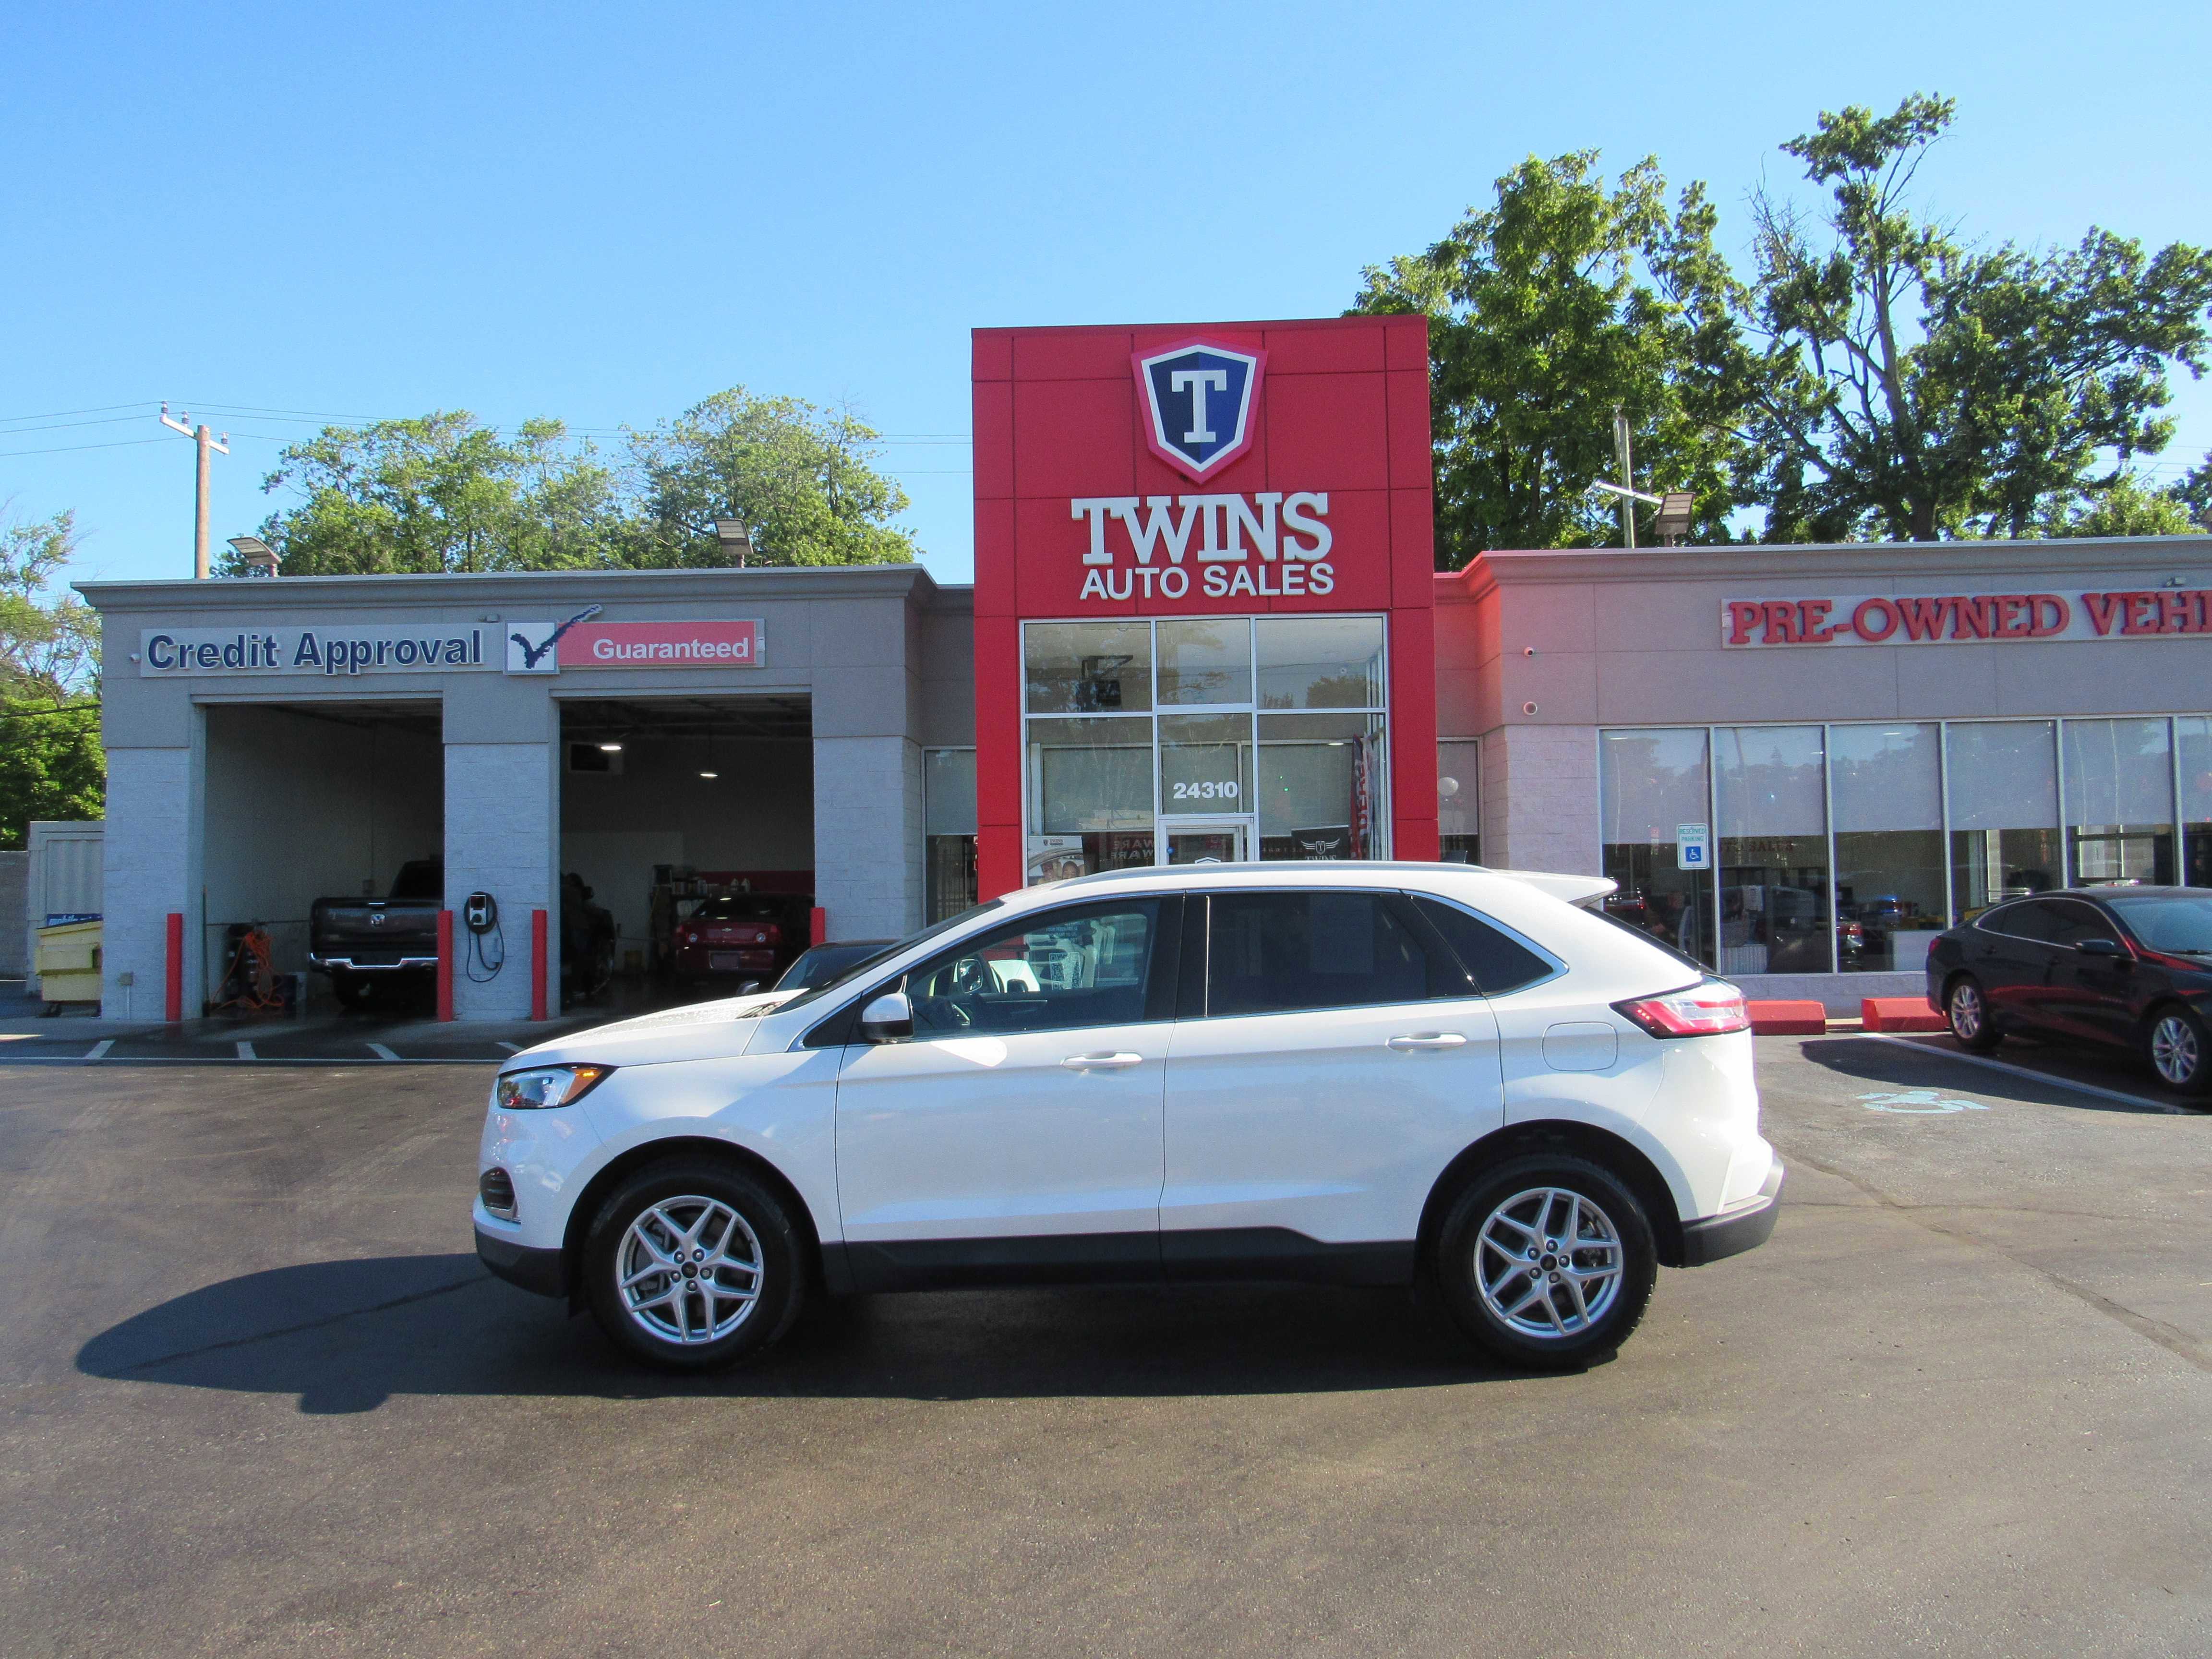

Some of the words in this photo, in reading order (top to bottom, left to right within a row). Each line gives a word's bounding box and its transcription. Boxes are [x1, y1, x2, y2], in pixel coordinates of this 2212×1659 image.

[1171, 370, 1227, 443] T
[1070, 492, 1333, 566] TWINS
[1079, 567, 1190, 600] AUTO
[1202, 563, 1334, 597] SALES
[1729, 594, 2070, 644] PRE-OWNED
[147, 633, 281, 669] Credit
[292, 629, 483, 675] Approval
[592, 637, 750, 660] Guaranteed
[1173, 781, 1238, 799] 24310
